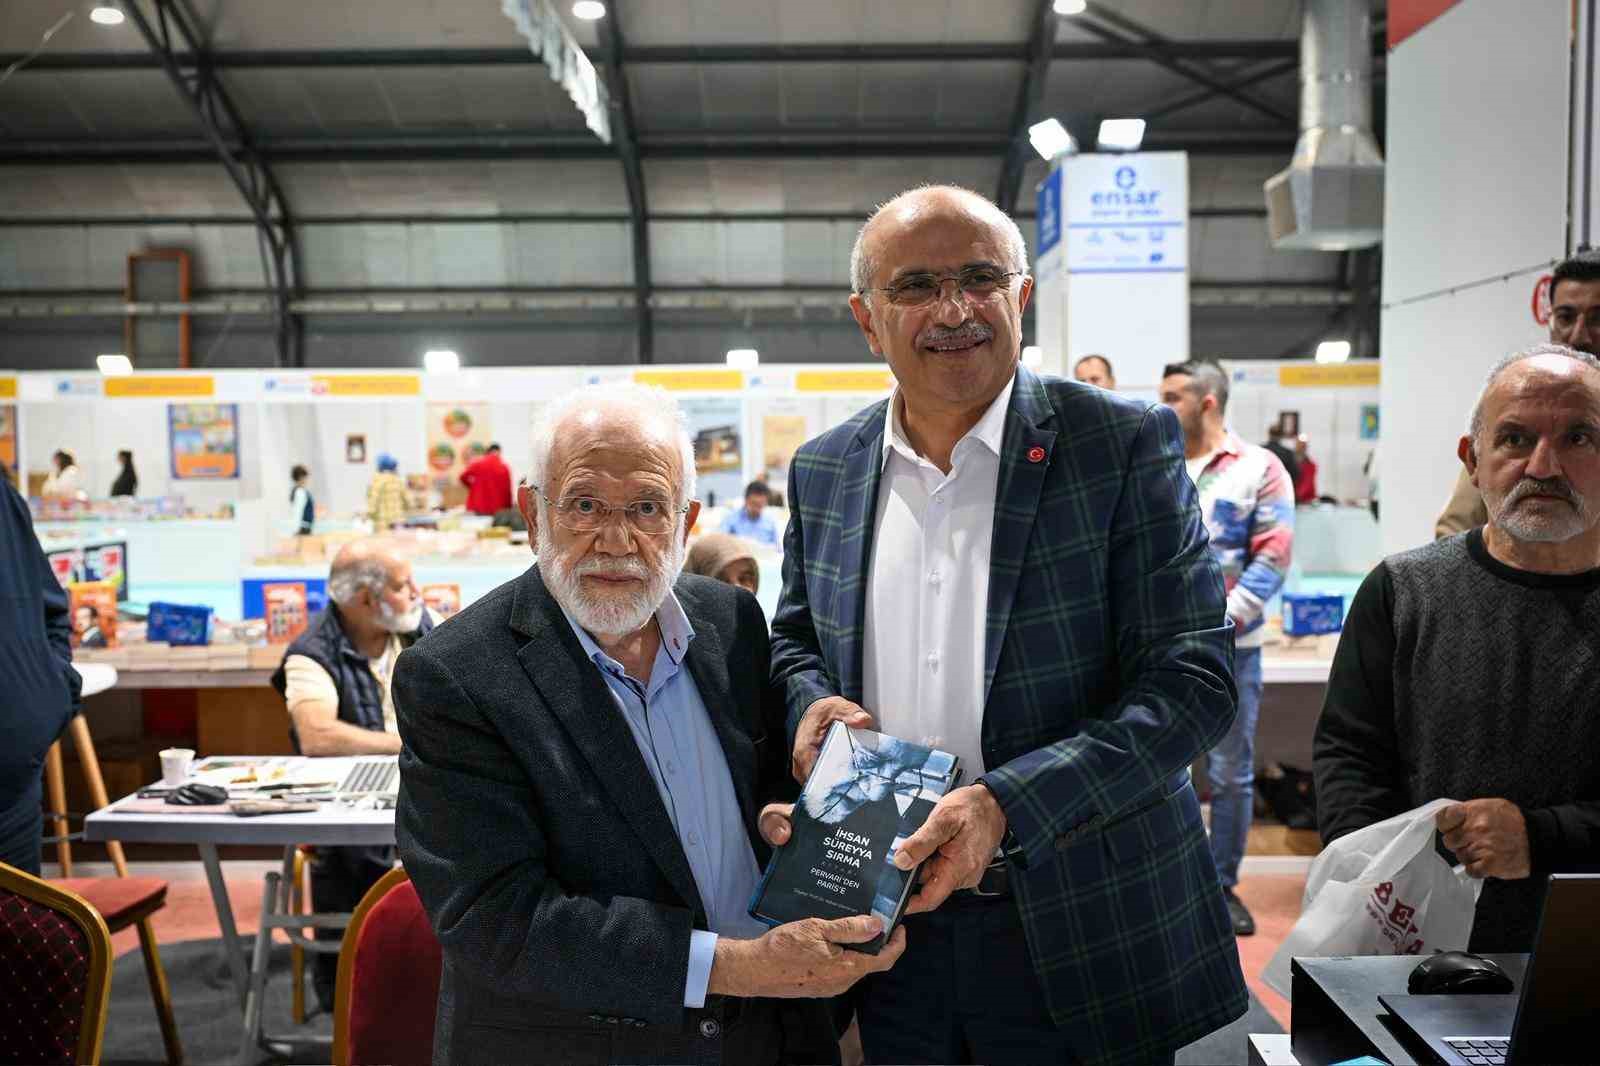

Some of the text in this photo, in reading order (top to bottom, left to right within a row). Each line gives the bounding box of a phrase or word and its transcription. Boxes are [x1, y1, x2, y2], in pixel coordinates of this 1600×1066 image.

[1091, 190, 1160, 205] ensar
[835, 826, 870, 847] İHSAN
[823, 836, 872, 860] SÜREYYA
[825, 849, 860, 868] SIRMA
